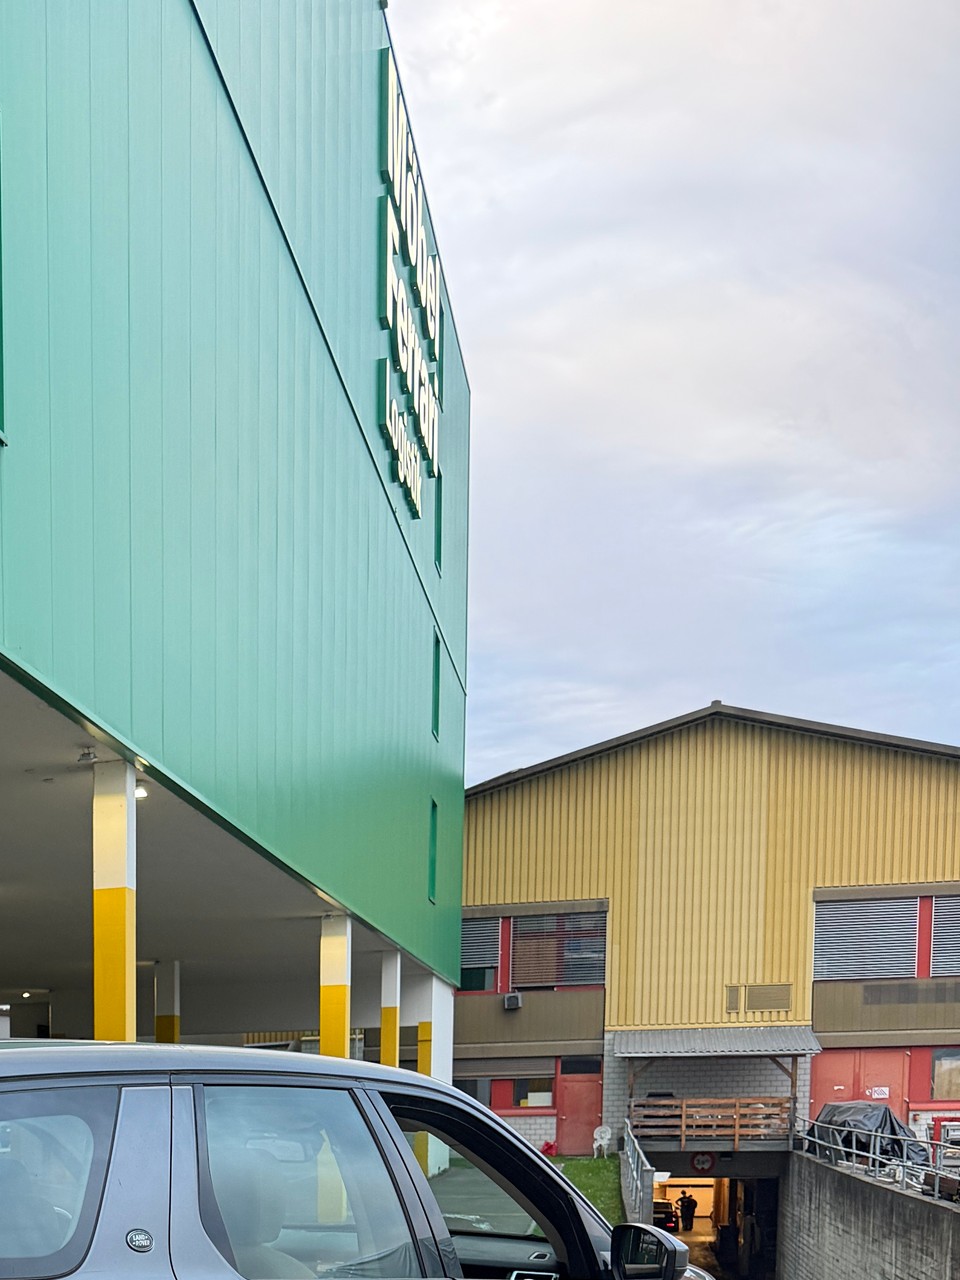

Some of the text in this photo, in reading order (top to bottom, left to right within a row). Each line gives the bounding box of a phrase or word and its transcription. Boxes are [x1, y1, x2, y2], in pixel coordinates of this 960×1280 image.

[386, 194, 438, 478] Ferrari
[388, 46, 440, 362] Möbel
[386, 358, 422, 519] Logistik
